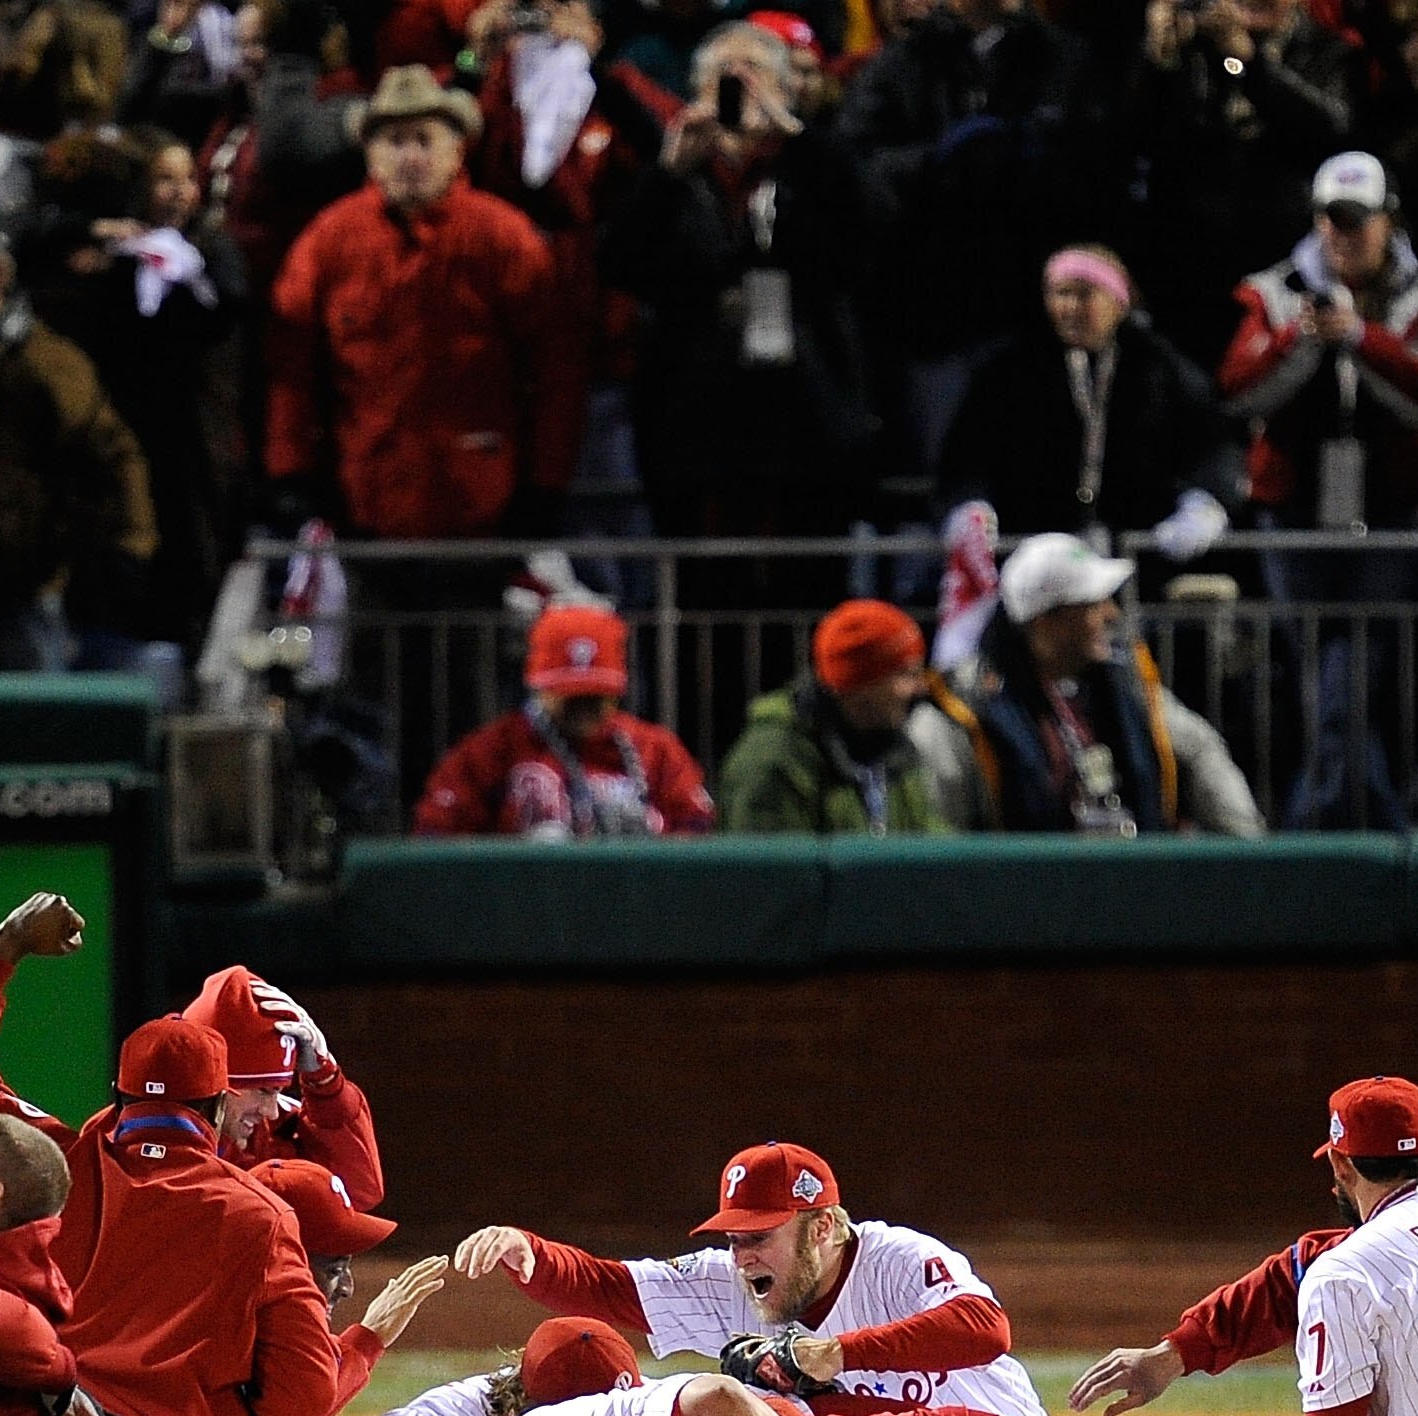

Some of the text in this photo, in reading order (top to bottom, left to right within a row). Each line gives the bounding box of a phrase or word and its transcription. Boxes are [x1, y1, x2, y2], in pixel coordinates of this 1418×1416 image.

[726, 1165, 746, 1199] P
[924, 1256, 955, 1288] 4
[1308, 1321, 1326, 1376] 7
